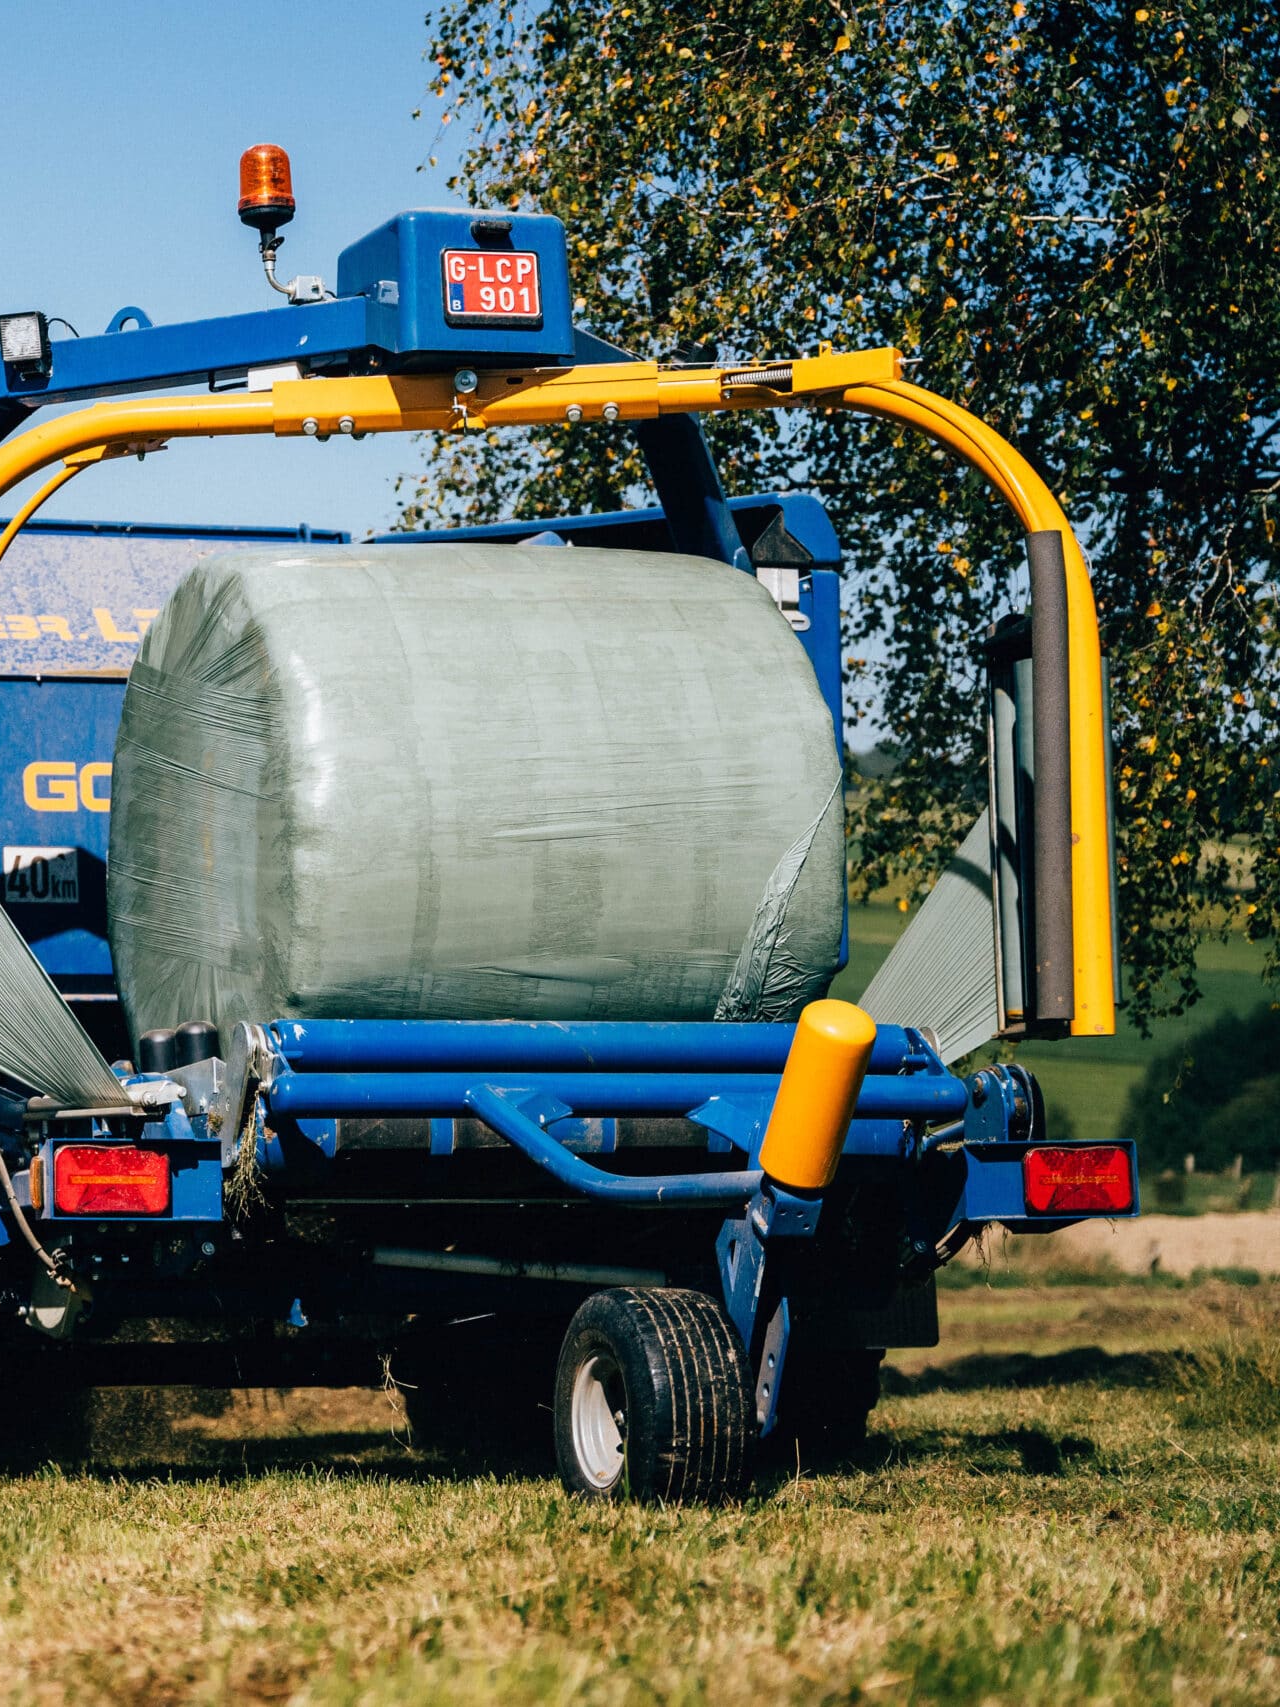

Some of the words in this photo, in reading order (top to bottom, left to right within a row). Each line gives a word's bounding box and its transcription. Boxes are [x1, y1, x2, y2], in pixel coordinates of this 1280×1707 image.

[449, 256, 532, 284] G-LCP
[452, 299, 462, 311] B
[479, 286, 530, 313] 901
